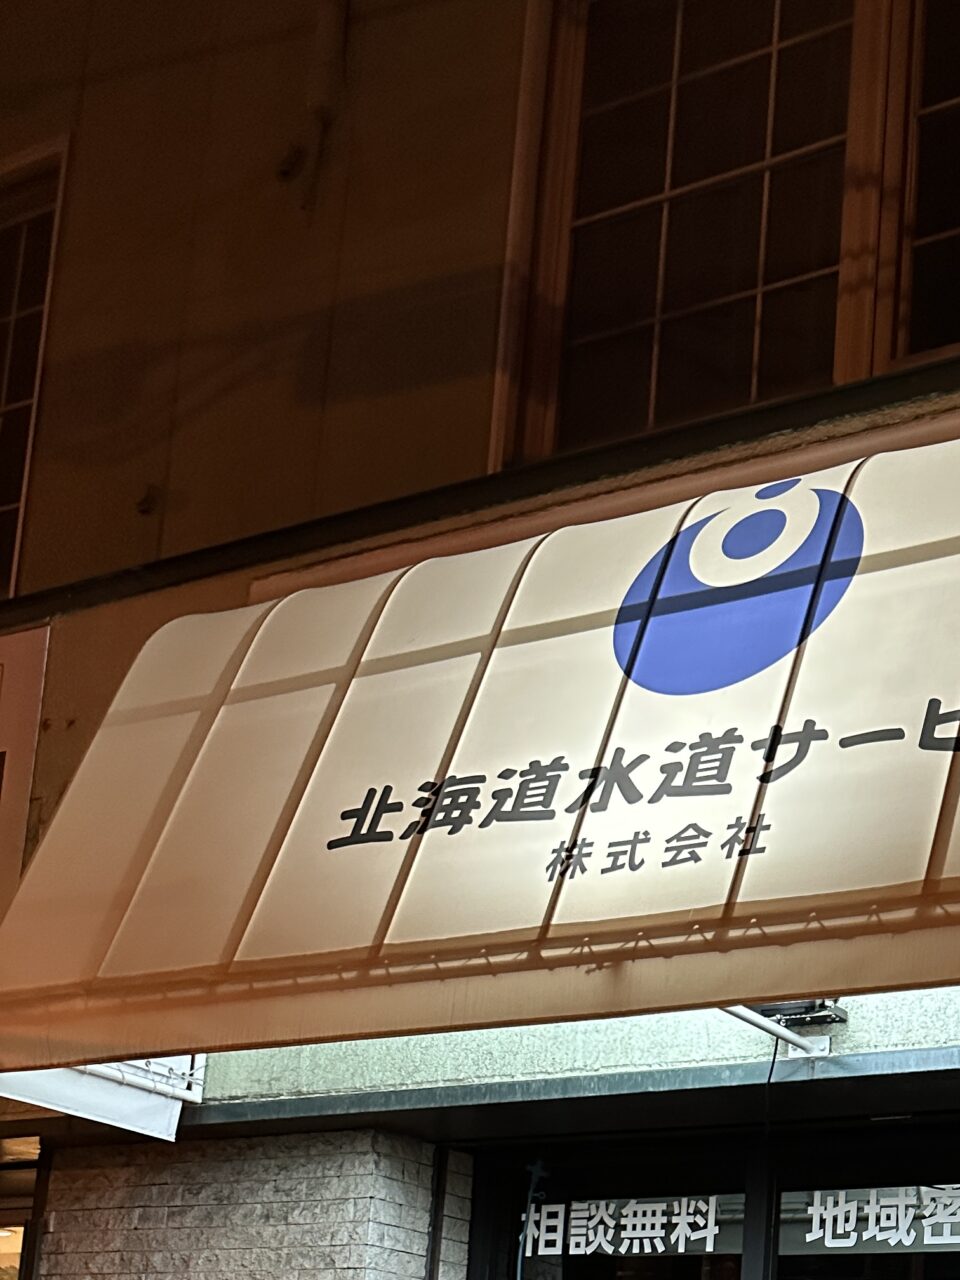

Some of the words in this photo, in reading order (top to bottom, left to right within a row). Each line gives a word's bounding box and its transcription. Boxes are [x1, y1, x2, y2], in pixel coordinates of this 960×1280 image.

[545, 813, 774, 882] 株式会社
[521, 1196, 720, 1257] 相談無料
